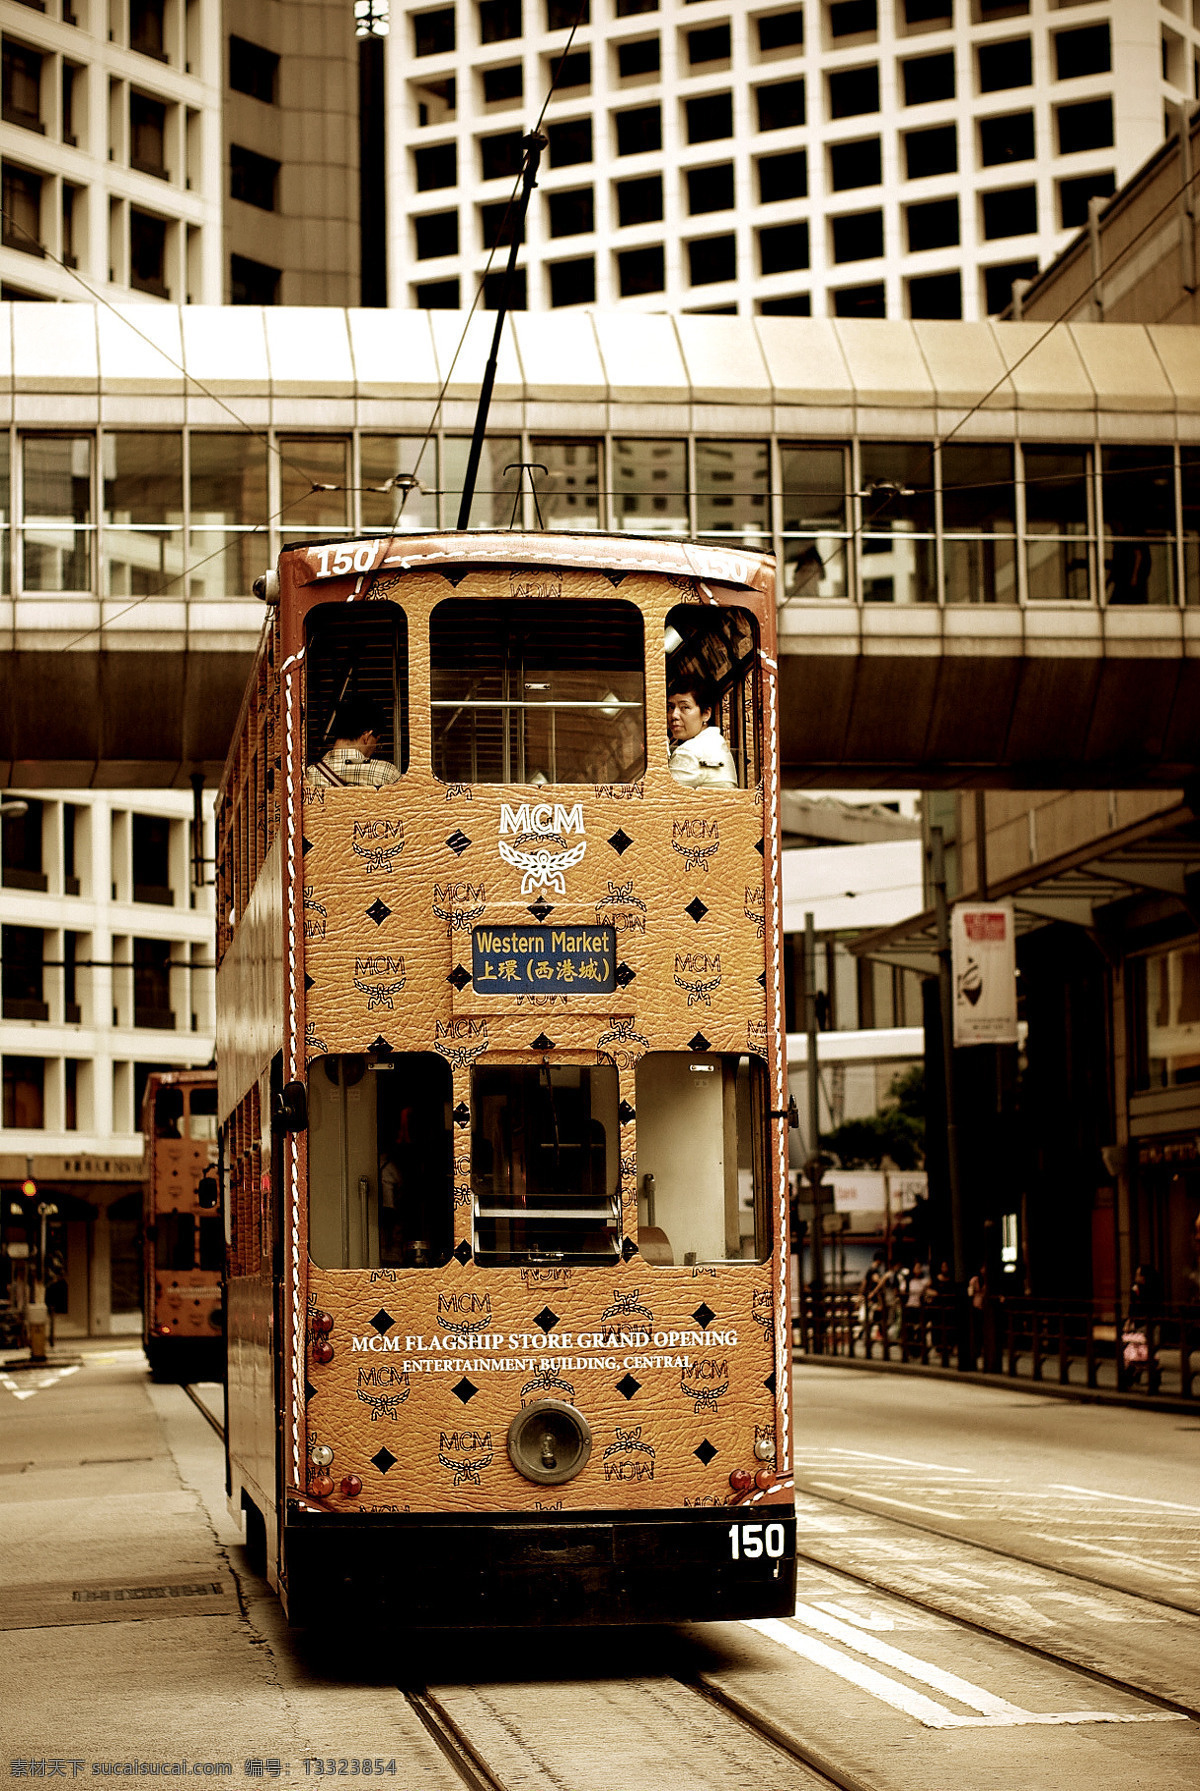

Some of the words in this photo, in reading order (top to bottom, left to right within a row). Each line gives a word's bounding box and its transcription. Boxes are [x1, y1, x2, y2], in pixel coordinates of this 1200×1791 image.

[316, 546, 376, 577] 150
[498, 803, 586, 835] MCM
[672, 819, 719, 839] MCM
[353, 820, 404, 840] MCM
[433, 882, 486, 902] MCM
[476, 931, 544, 953] Western
[551, 931, 609, 953] Market
[354, 956, 405, 976] MCM
[674, 953, 721, 973] MCM
[435, 1019, 488, 1039] MCM
[437, 1293, 492, 1313] MCM
[351, 1335, 400, 1351] MCM
[405, 1334, 504, 1350] FLAGSHIP
[508, 1333, 573, 1350] STORE
[577, 1332, 650, 1349] GRAND
[653, 1330, 738, 1347] OPENING
[402, 1358, 537, 1373] ENTERTAINMENT
[540, 1356, 620, 1371] BUILDING,
[623, 1355, 693, 1369] CENTRAL
[681, 1359, 729, 1379] MCM
[357, 1366, 411, 1387] MCM
[439, 1431, 493, 1451] MCM
[603, 1460, 654, 1481] MCM
[728, 1523, 785, 1560] 150
